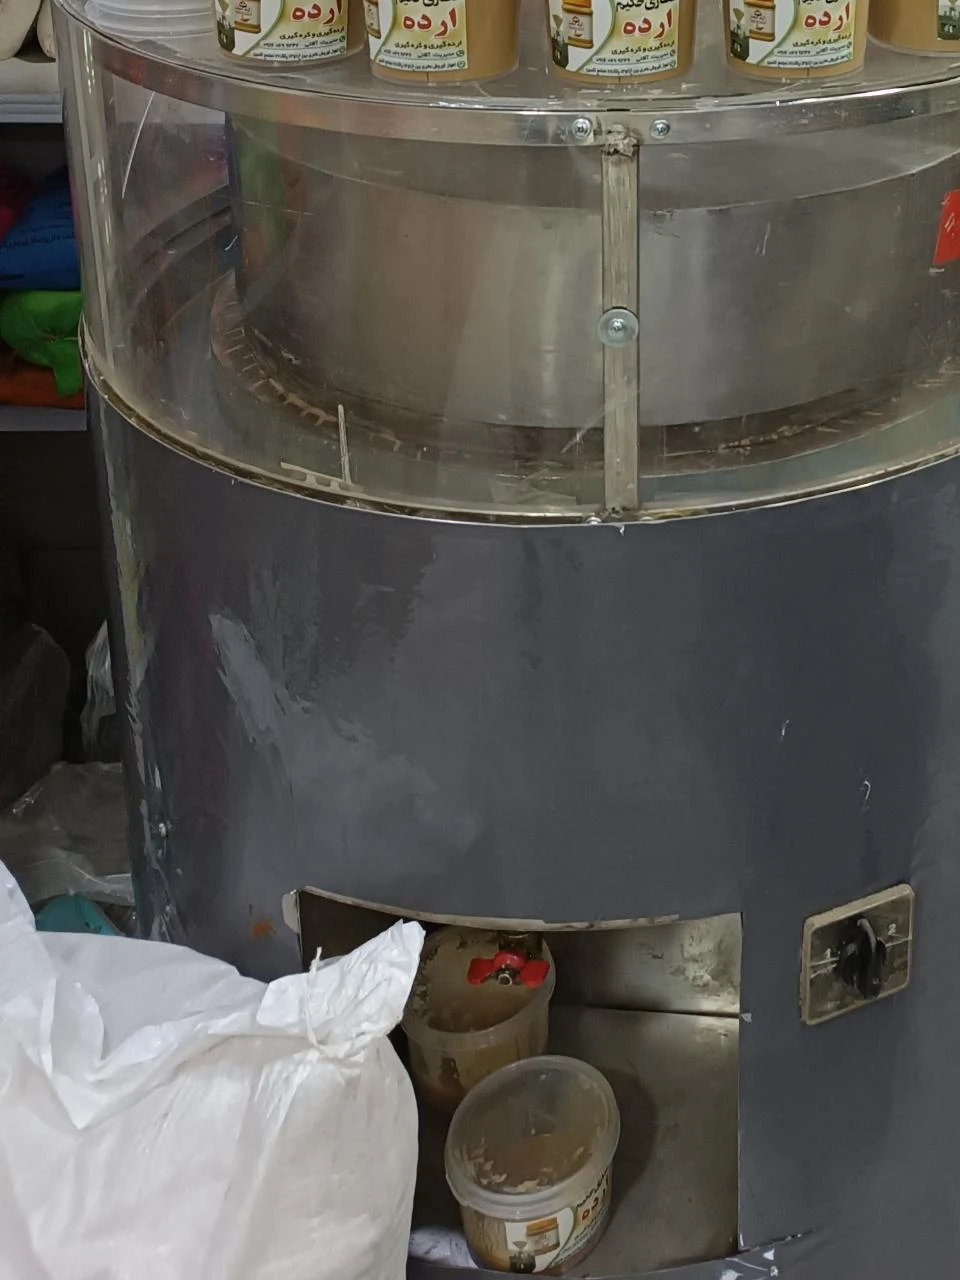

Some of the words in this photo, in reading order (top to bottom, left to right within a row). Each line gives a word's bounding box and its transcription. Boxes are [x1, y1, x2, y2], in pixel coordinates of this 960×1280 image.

[402, 7, 457, 38] ارده
[623, 8, 672, 39] ارده
[803, 1, 850, 32] ارده
